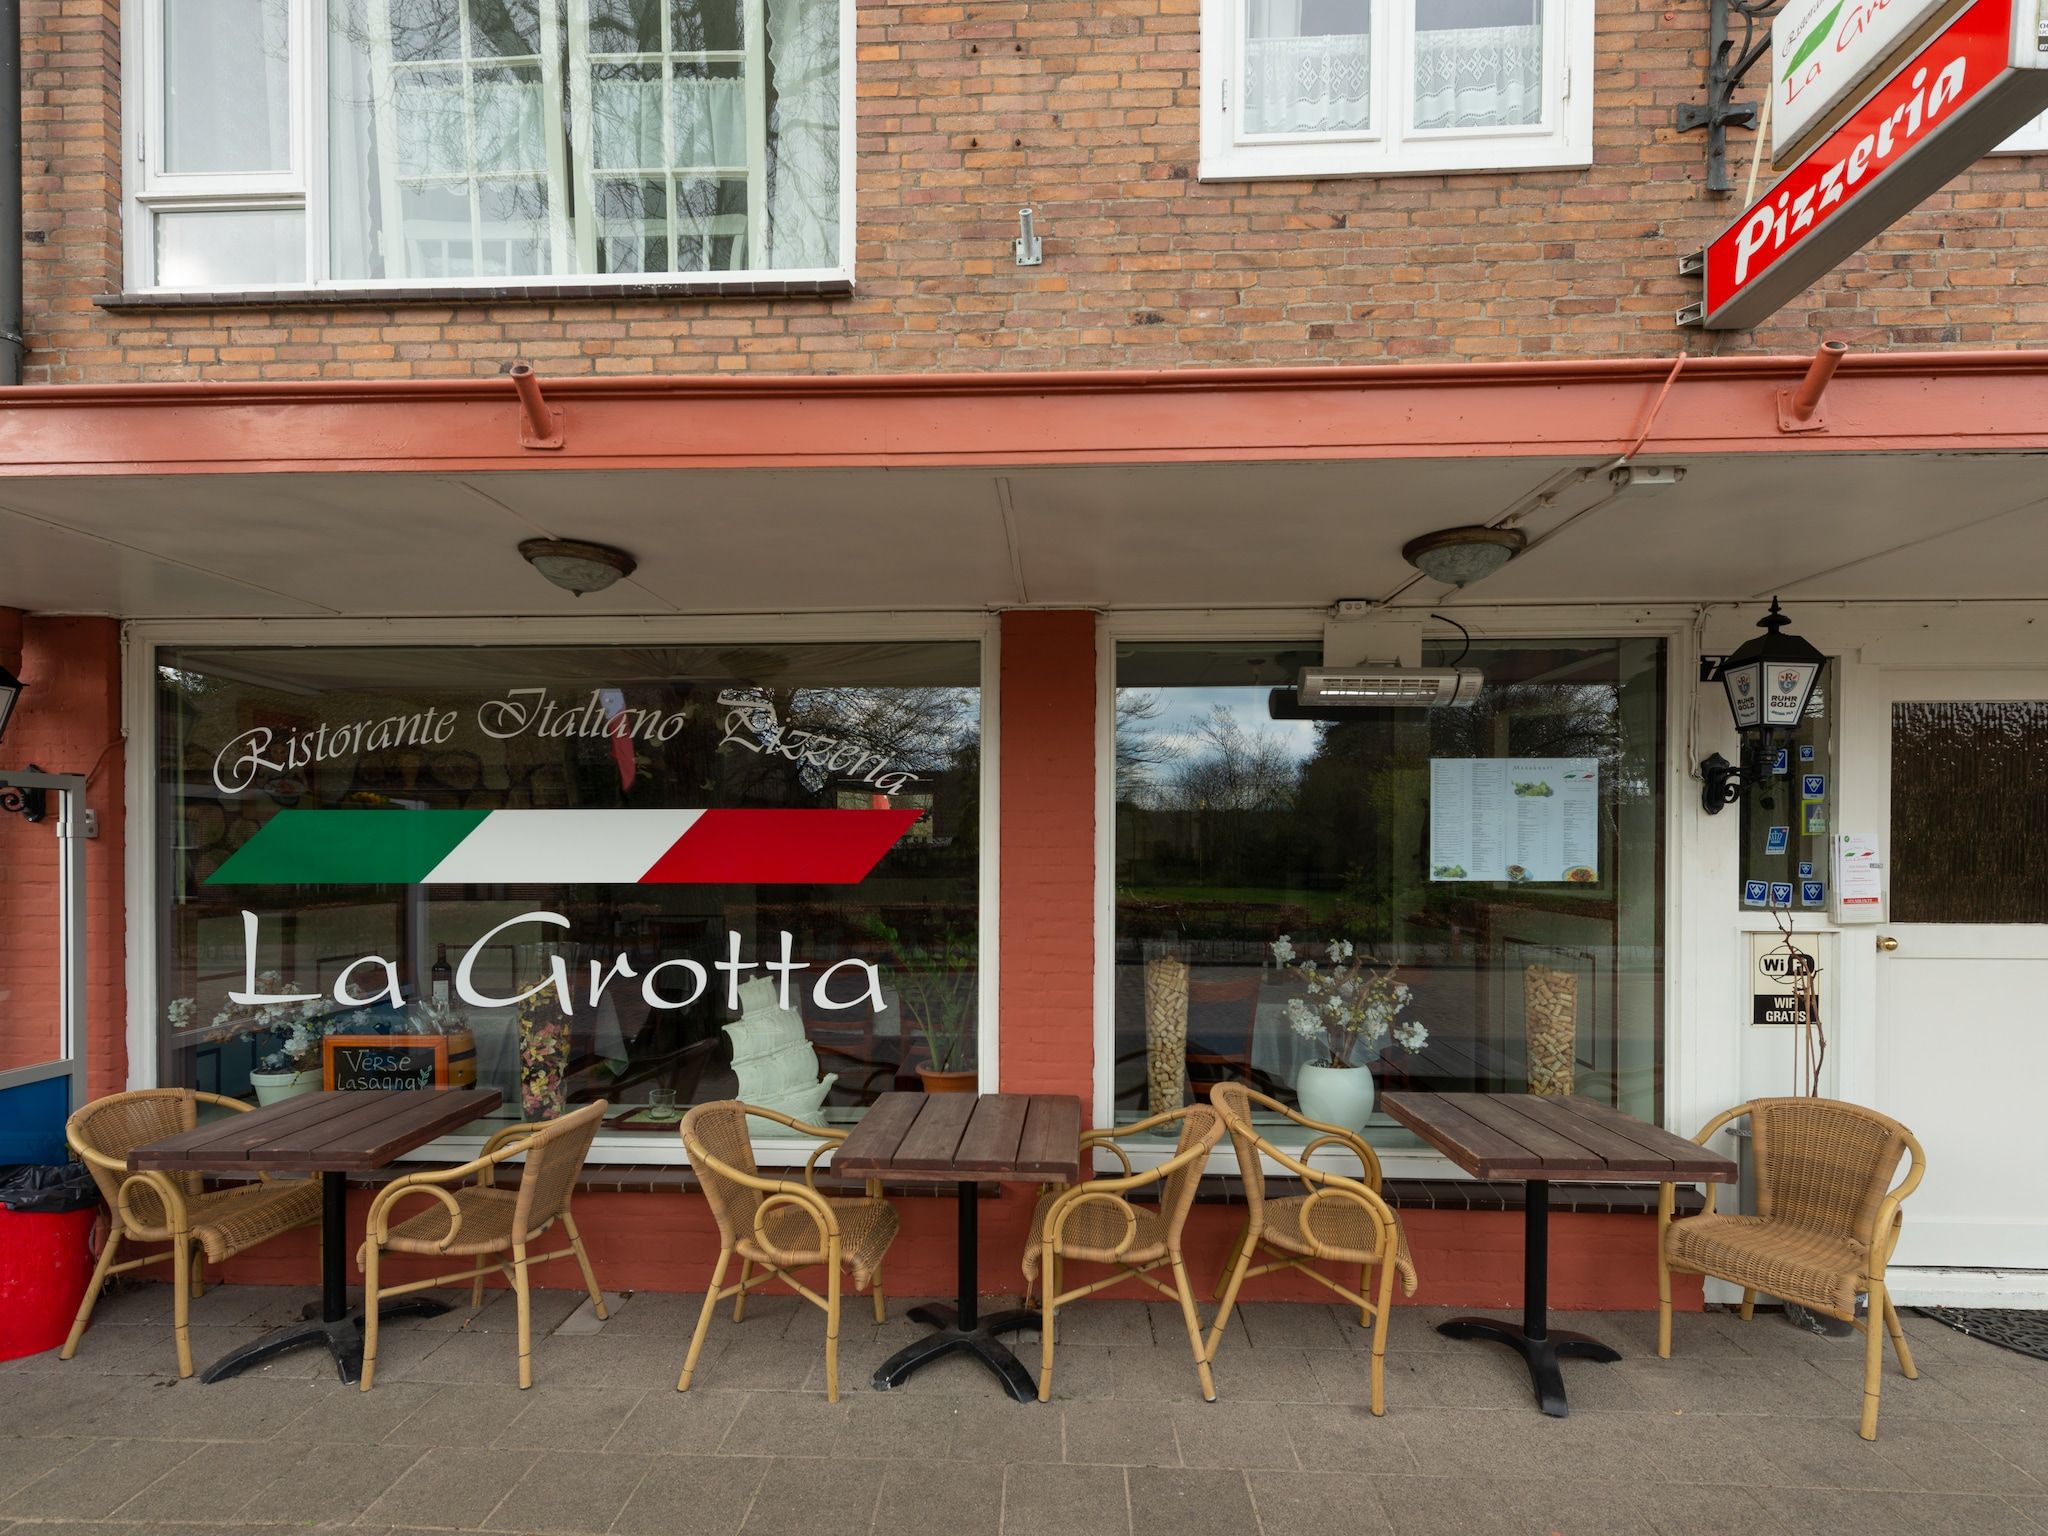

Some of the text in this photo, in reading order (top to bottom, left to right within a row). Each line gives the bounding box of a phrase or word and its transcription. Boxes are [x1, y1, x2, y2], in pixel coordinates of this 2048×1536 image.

[1785, 62, 1821, 106] La
[1735, 56, 1967, 286] Pizzeria
[1704, 656, 1728, 681] 7
[212, 687, 920, 796] Ristorante Italiano Pizzeria
[226, 910, 888, 1016] La Grotta
[1765, 1010, 1806, 1022] GRATS
[1774, 997, 1798, 1009] WIF
